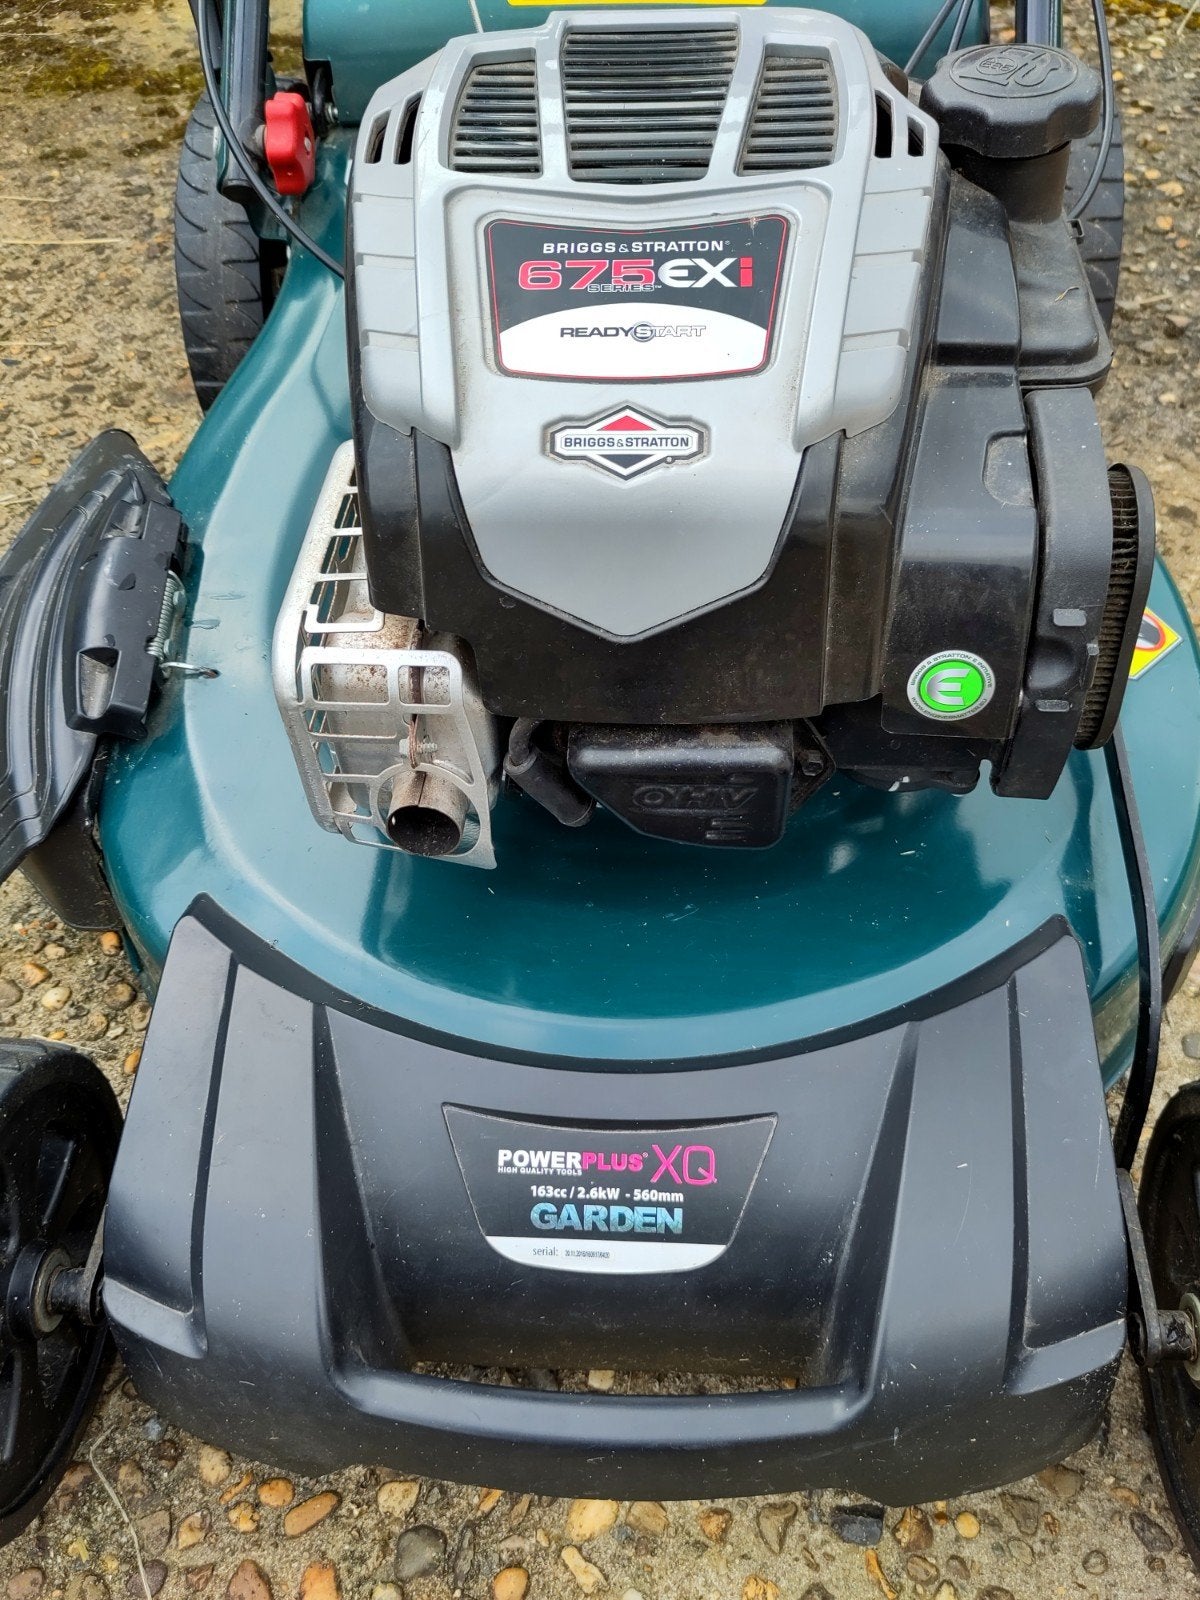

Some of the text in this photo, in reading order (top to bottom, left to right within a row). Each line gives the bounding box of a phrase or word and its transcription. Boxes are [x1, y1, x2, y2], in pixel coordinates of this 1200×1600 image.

[542, 240, 724, 254] BRIGGS & STRATTON
[587, 283, 655, 293] SERIES
[564, 437, 689, 448] BRIGGS & STRATTON
[498, 1166, 582, 1176] HIGH QUALITY TOOLS
[650, 1144, 718, 1186] XQ
[530, 1185, 567, 1199] 163cc
[577, 1186, 620, 1200] 2.6kW
[633, 1189, 684, 1202] 560mm
[530, 1202, 683, 1234] GARDEN
[532, 1246, 559, 1257] serial:
